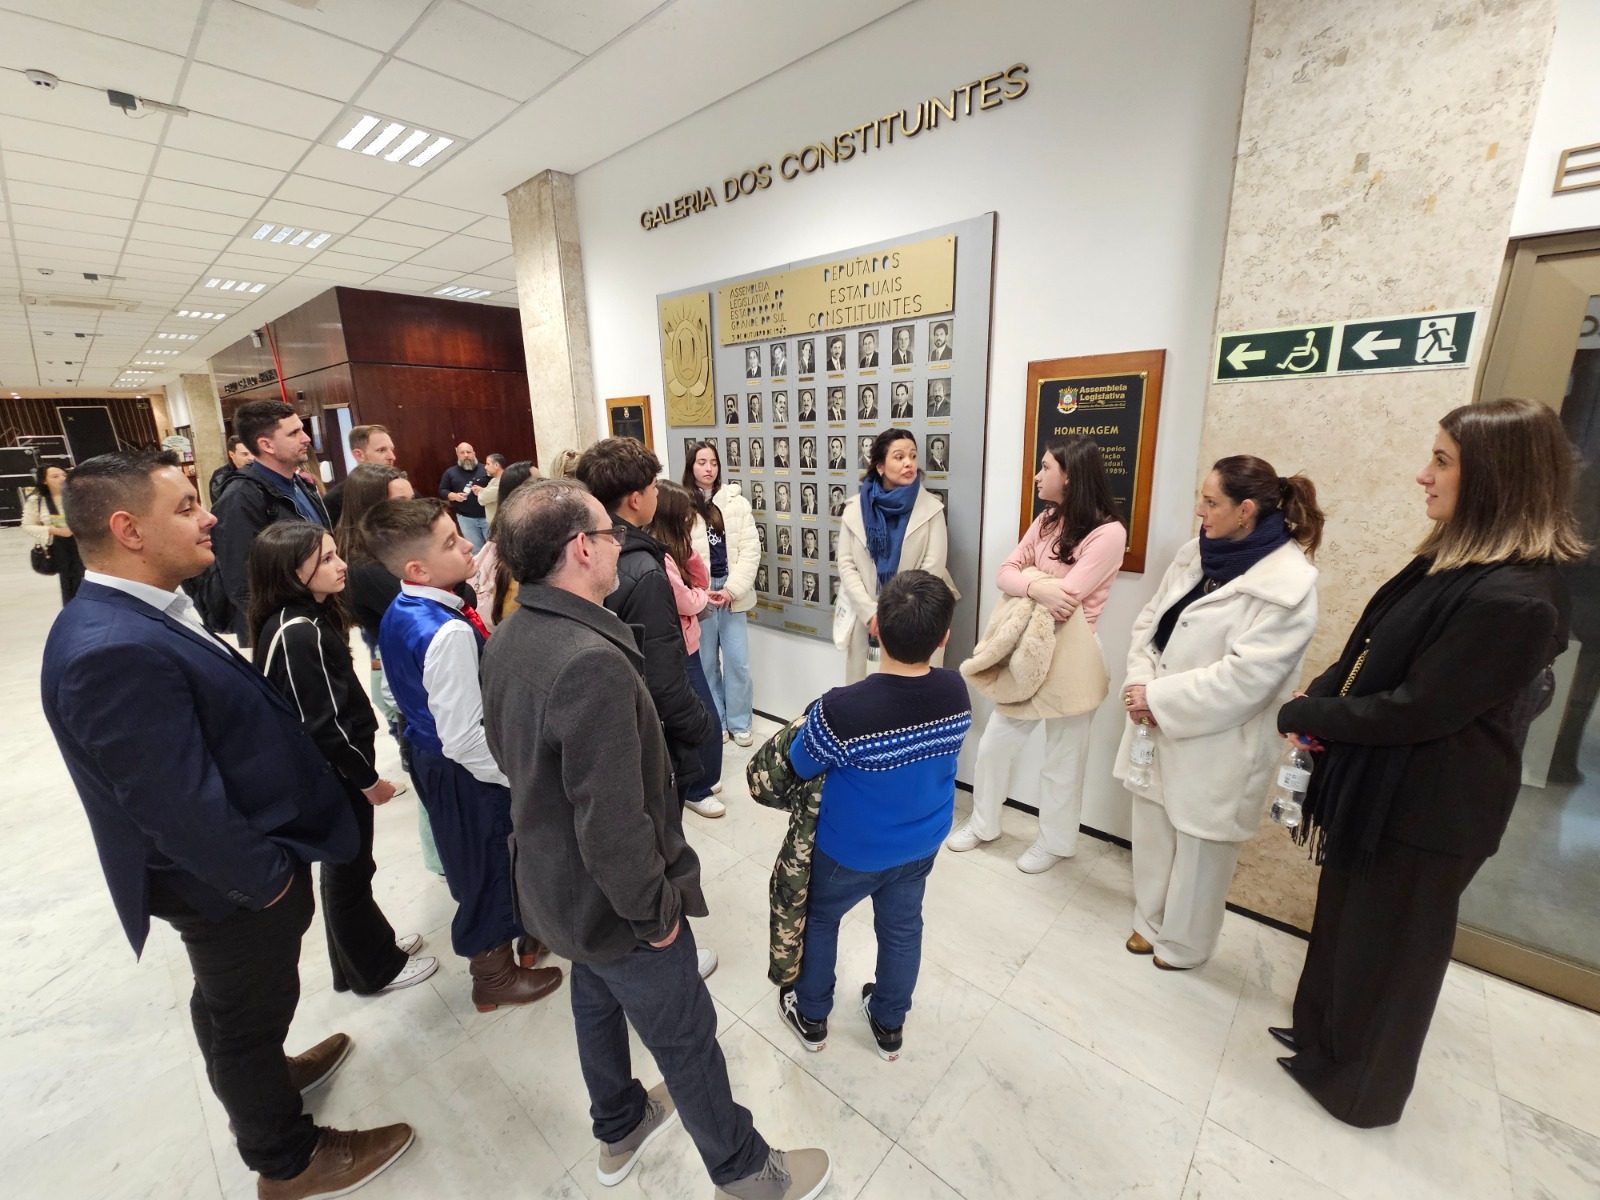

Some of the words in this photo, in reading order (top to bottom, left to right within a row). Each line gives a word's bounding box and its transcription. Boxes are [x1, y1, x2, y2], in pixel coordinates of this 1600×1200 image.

[640, 187, 717, 231] GALERIA
[722, 163, 772, 203] DOS
[780, 62, 1029, 181] CONSTITUINTES
[830, 276, 903, 305] ESTADUAIS
[808, 294, 922, 329] CONSTITUINTES
[1080, 384, 1128, 394] Assembleia
[1080, 392, 1126, 402] Legislativa
[1054, 425, 1119, 436] HOMENAGEM
[1102, 452, 1121, 460] lação
